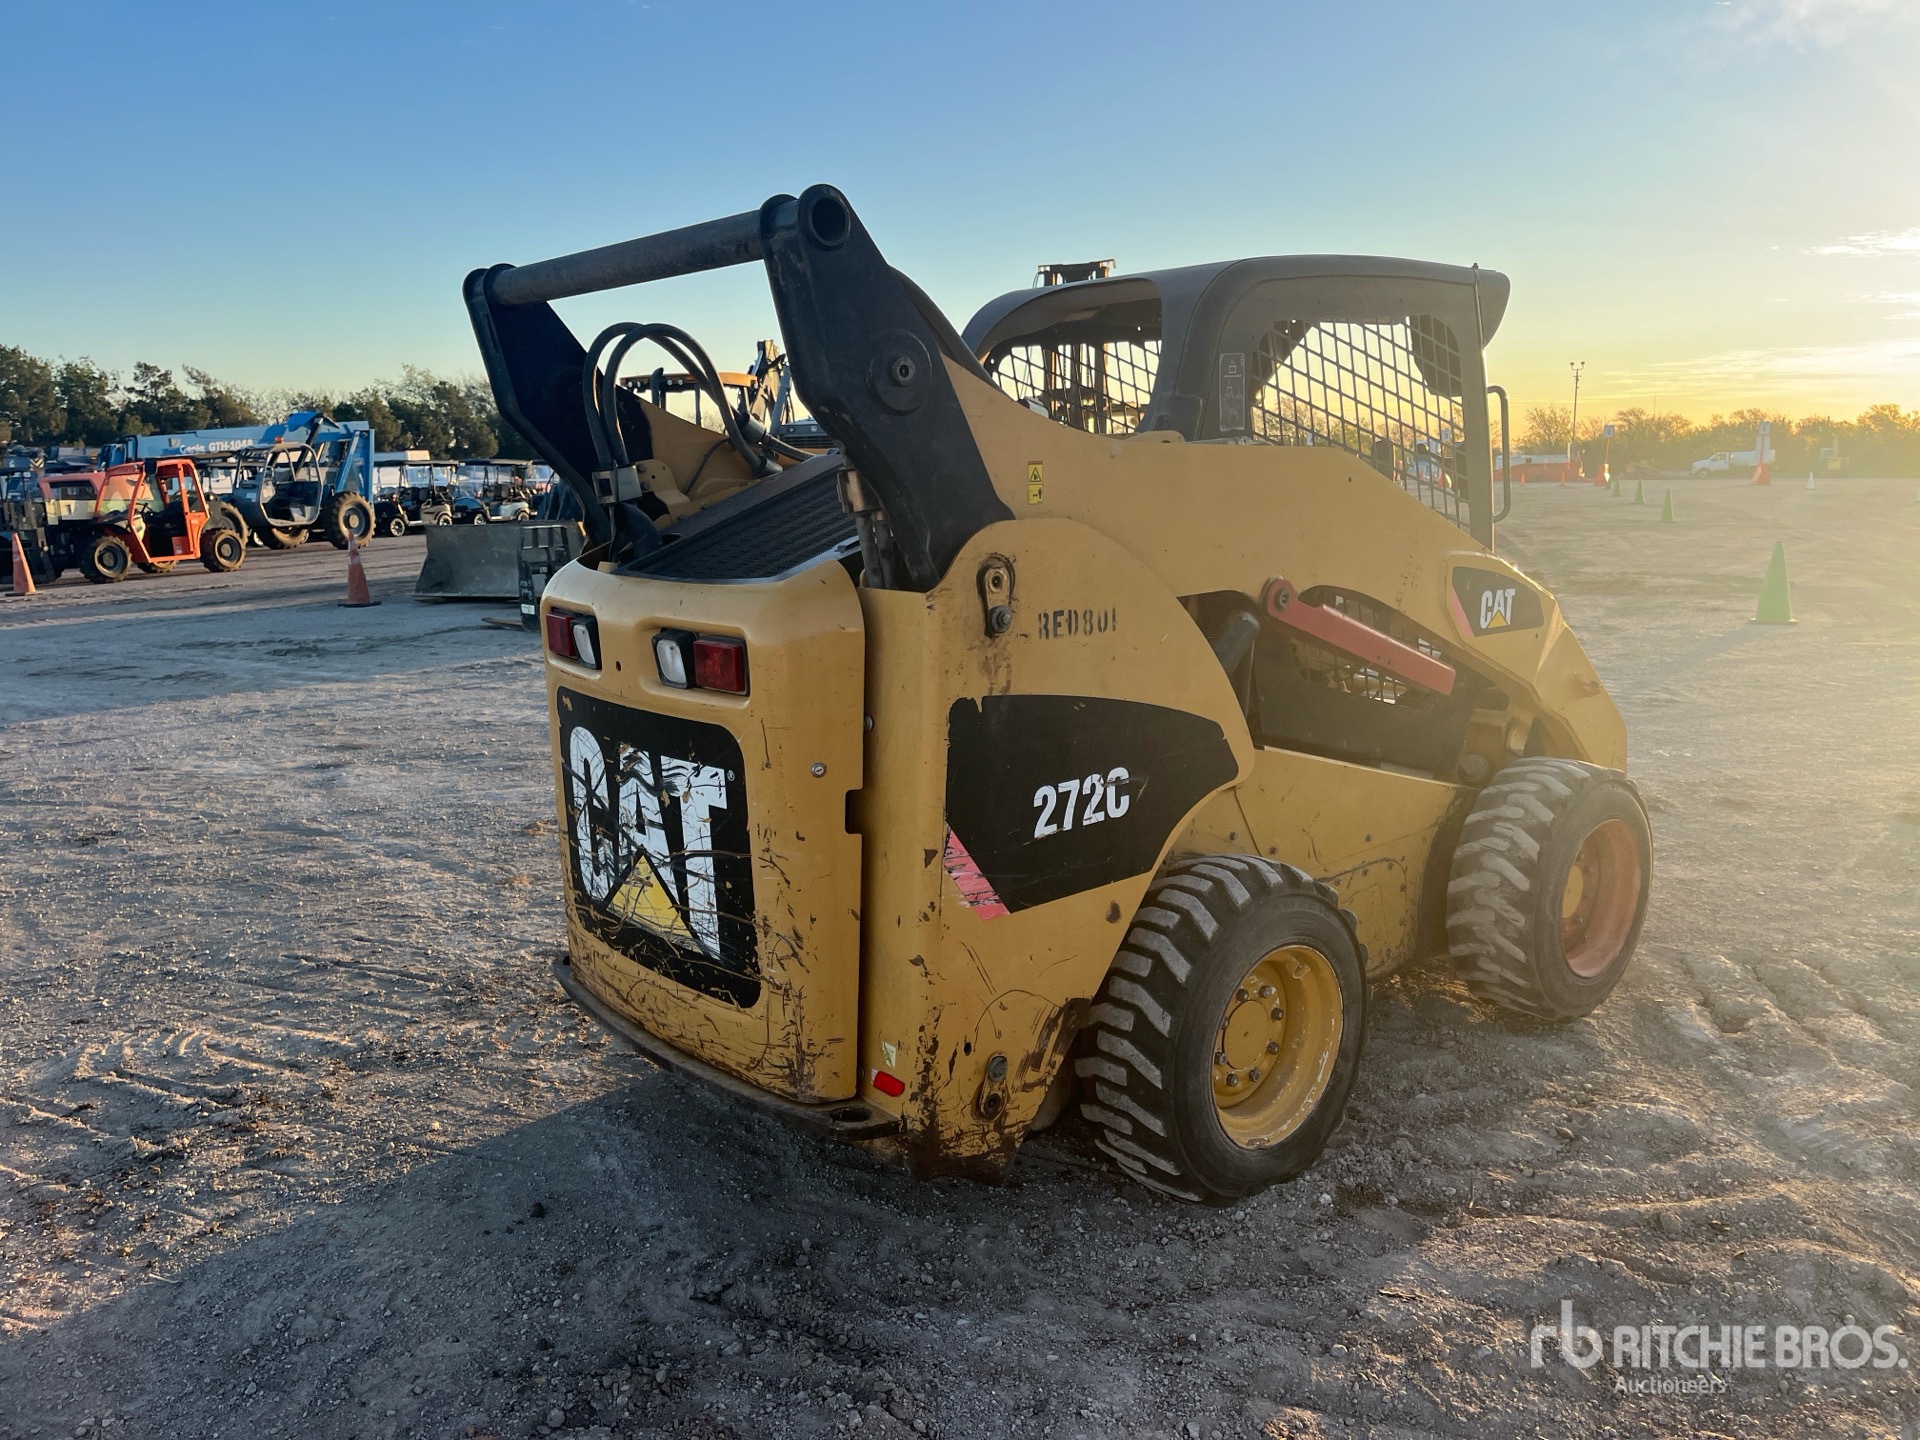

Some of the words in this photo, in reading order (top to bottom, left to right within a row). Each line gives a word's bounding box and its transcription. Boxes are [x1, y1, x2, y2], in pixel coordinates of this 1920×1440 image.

[1480, 588, 1516, 630] CAT
[1033, 767, 1130, 839] 272C
[569, 726, 729, 961] CAT
